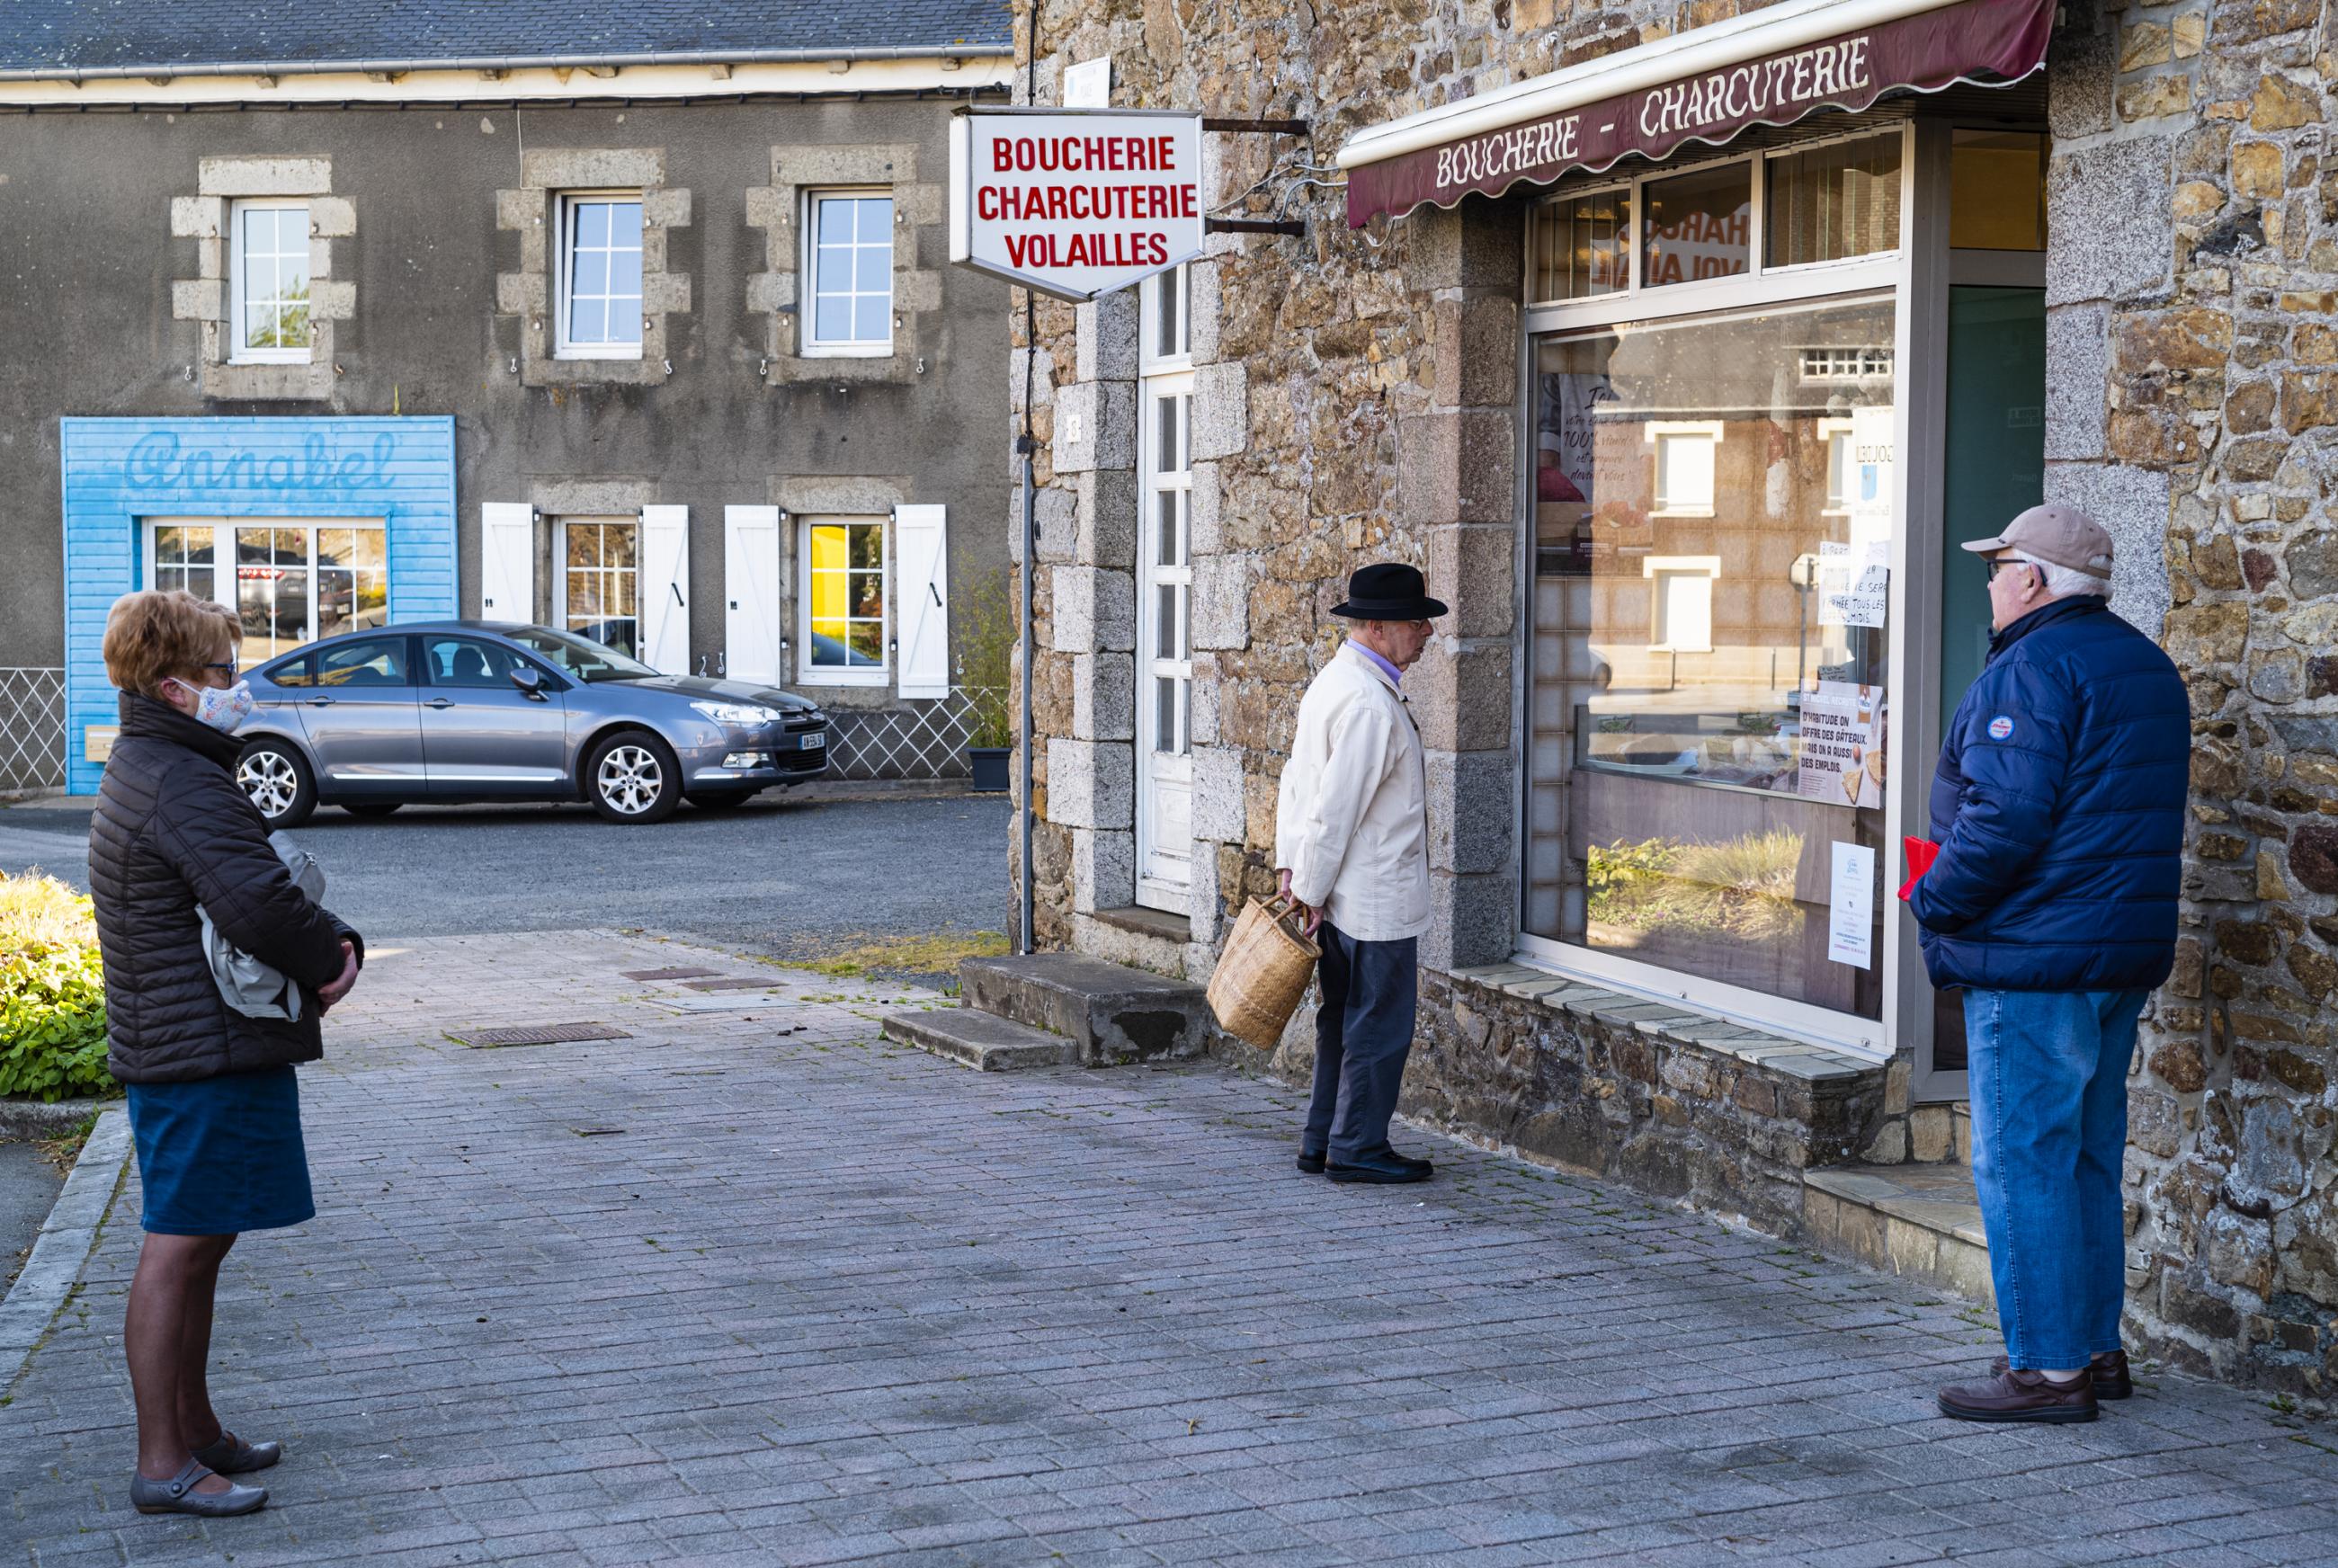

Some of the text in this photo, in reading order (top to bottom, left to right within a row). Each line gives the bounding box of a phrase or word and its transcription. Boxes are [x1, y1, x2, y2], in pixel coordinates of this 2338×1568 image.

[1436, 115, 1580, 188] BOUCHERIE
[1640, 36, 1870, 137] CHARCUTERIE
[993, 137, 1175, 173] BOUCHERIE
[978, 184, 1198, 220] CHARCUTERIE
[1004, 233, 1168, 268] VOLAILLES
[1565, 431, 1599, 448] 100%
[124, 431, 397, 489] Annabel
[1852, 598, 1870, 610] TOUS
[1872, 599, 1885, 610] LES
[1803, 711, 1849, 726] D'HABITUDE ON
[1802, 726, 1821, 739] OFFRE
[1822, 729, 1834, 741] DES
[1801, 742, 1852, 759] MAIS ON A AUSSI
[1801, 757, 1842, 774] DES EMPLOIS.
